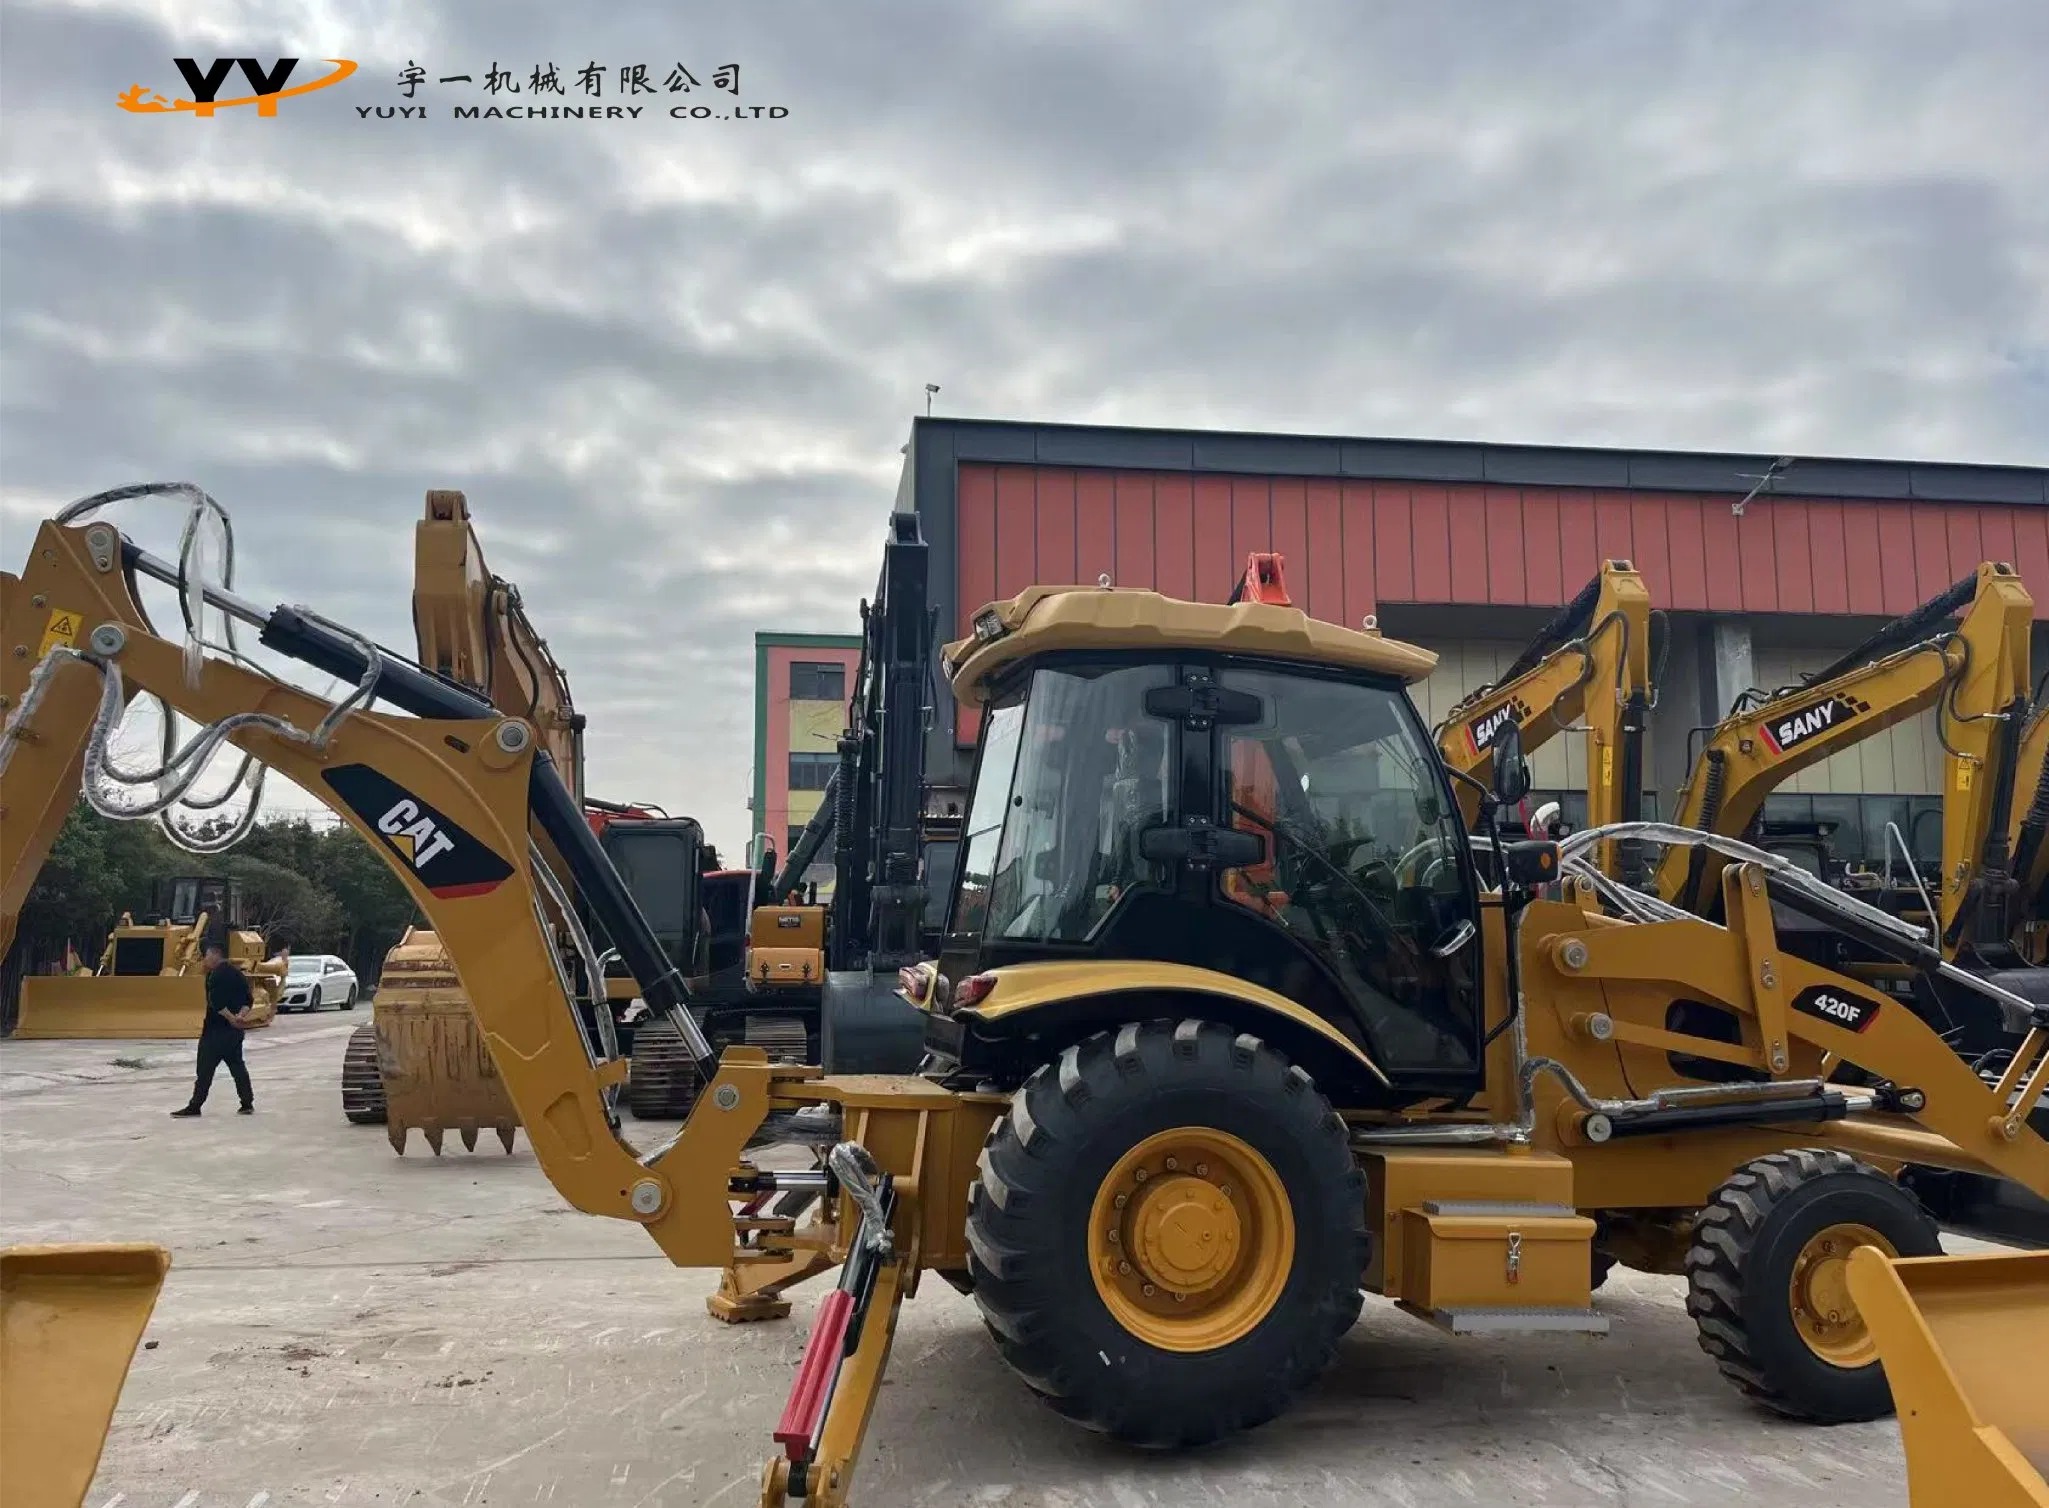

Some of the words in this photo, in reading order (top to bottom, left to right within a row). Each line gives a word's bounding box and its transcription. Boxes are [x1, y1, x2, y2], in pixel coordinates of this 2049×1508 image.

[1778, 700, 1834, 746] SANY
[378, 799, 455, 868] CAT
[1814, 994, 1861, 1022] 420F
